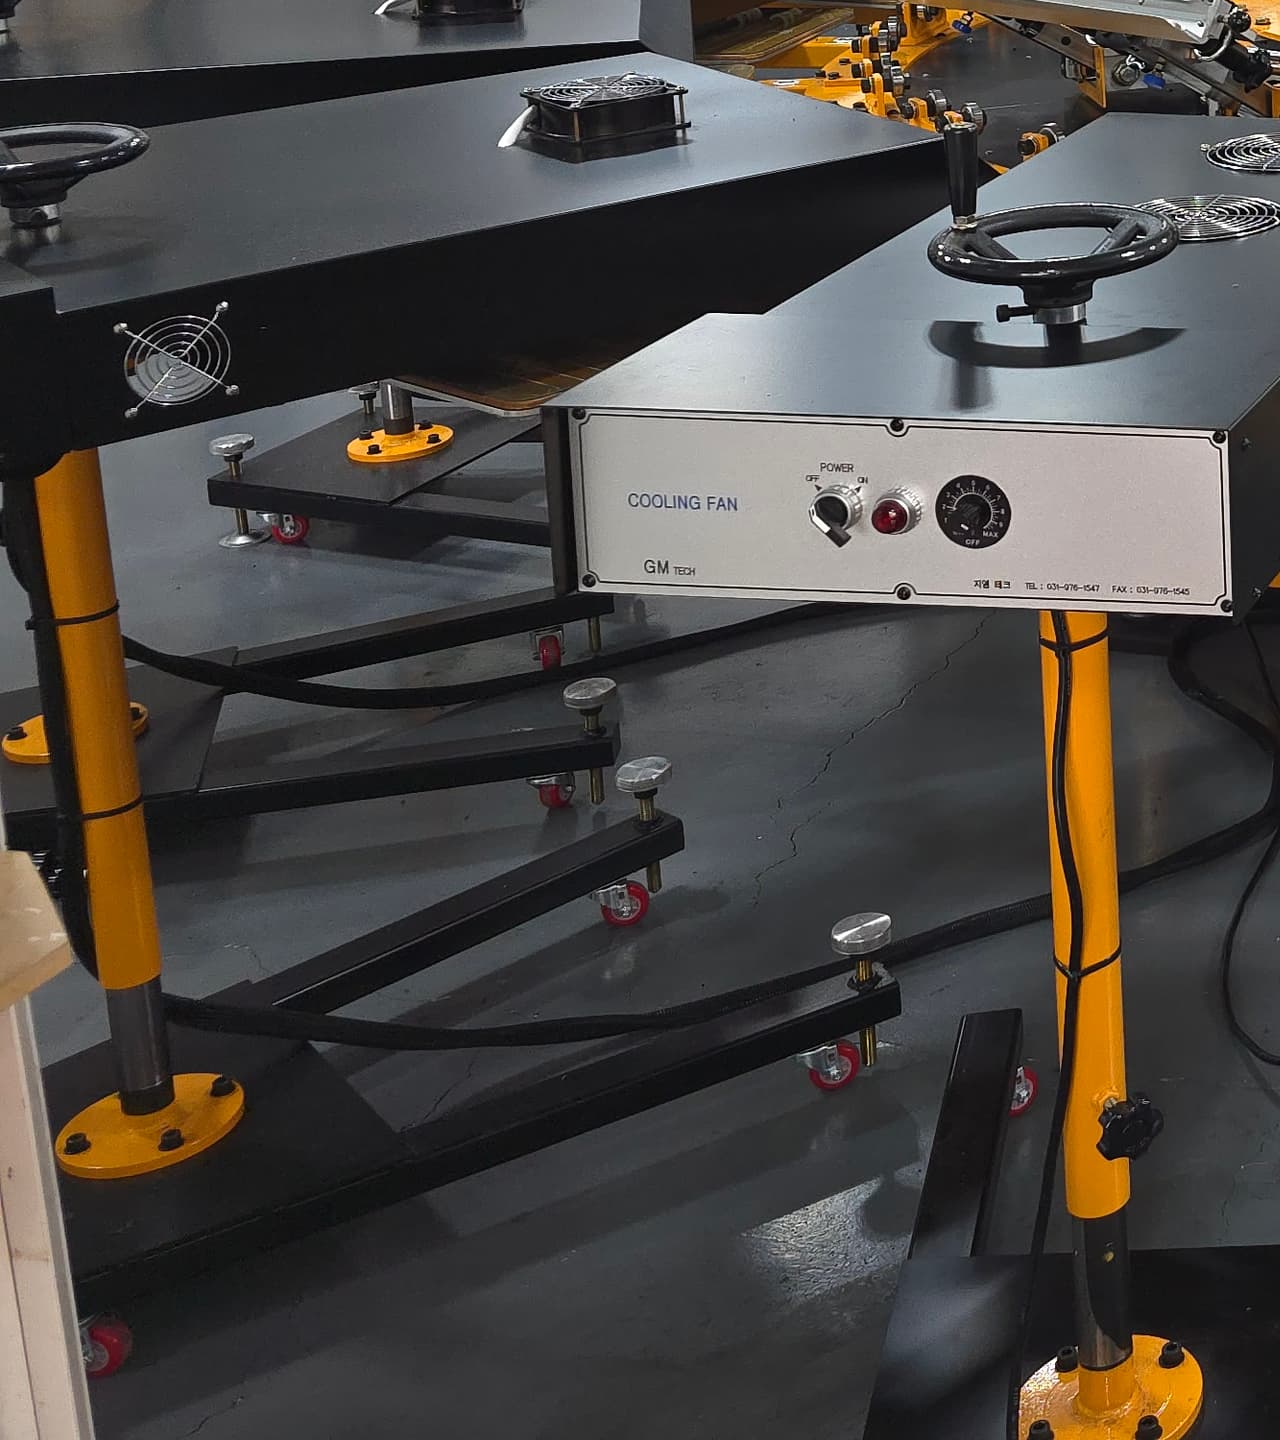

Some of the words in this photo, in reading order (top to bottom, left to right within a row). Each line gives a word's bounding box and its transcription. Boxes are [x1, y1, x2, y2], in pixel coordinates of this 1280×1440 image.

[820, 463, 854, 473] POWER
[857, 476, 868, 484] ON
[628, 493, 701, 510] COOLING
[707, 496, 738, 511] FAN
[983, 530, 999, 538] MAX
[643, 559, 669, 575] GM
[673, 566, 696, 576] TECH
[973, 580, 990, 589] 지엠
[994, 580, 1011, 589] 테크
[1025, 582, 1038, 590] TEL
[1112, 585, 1128, 593] FAX
